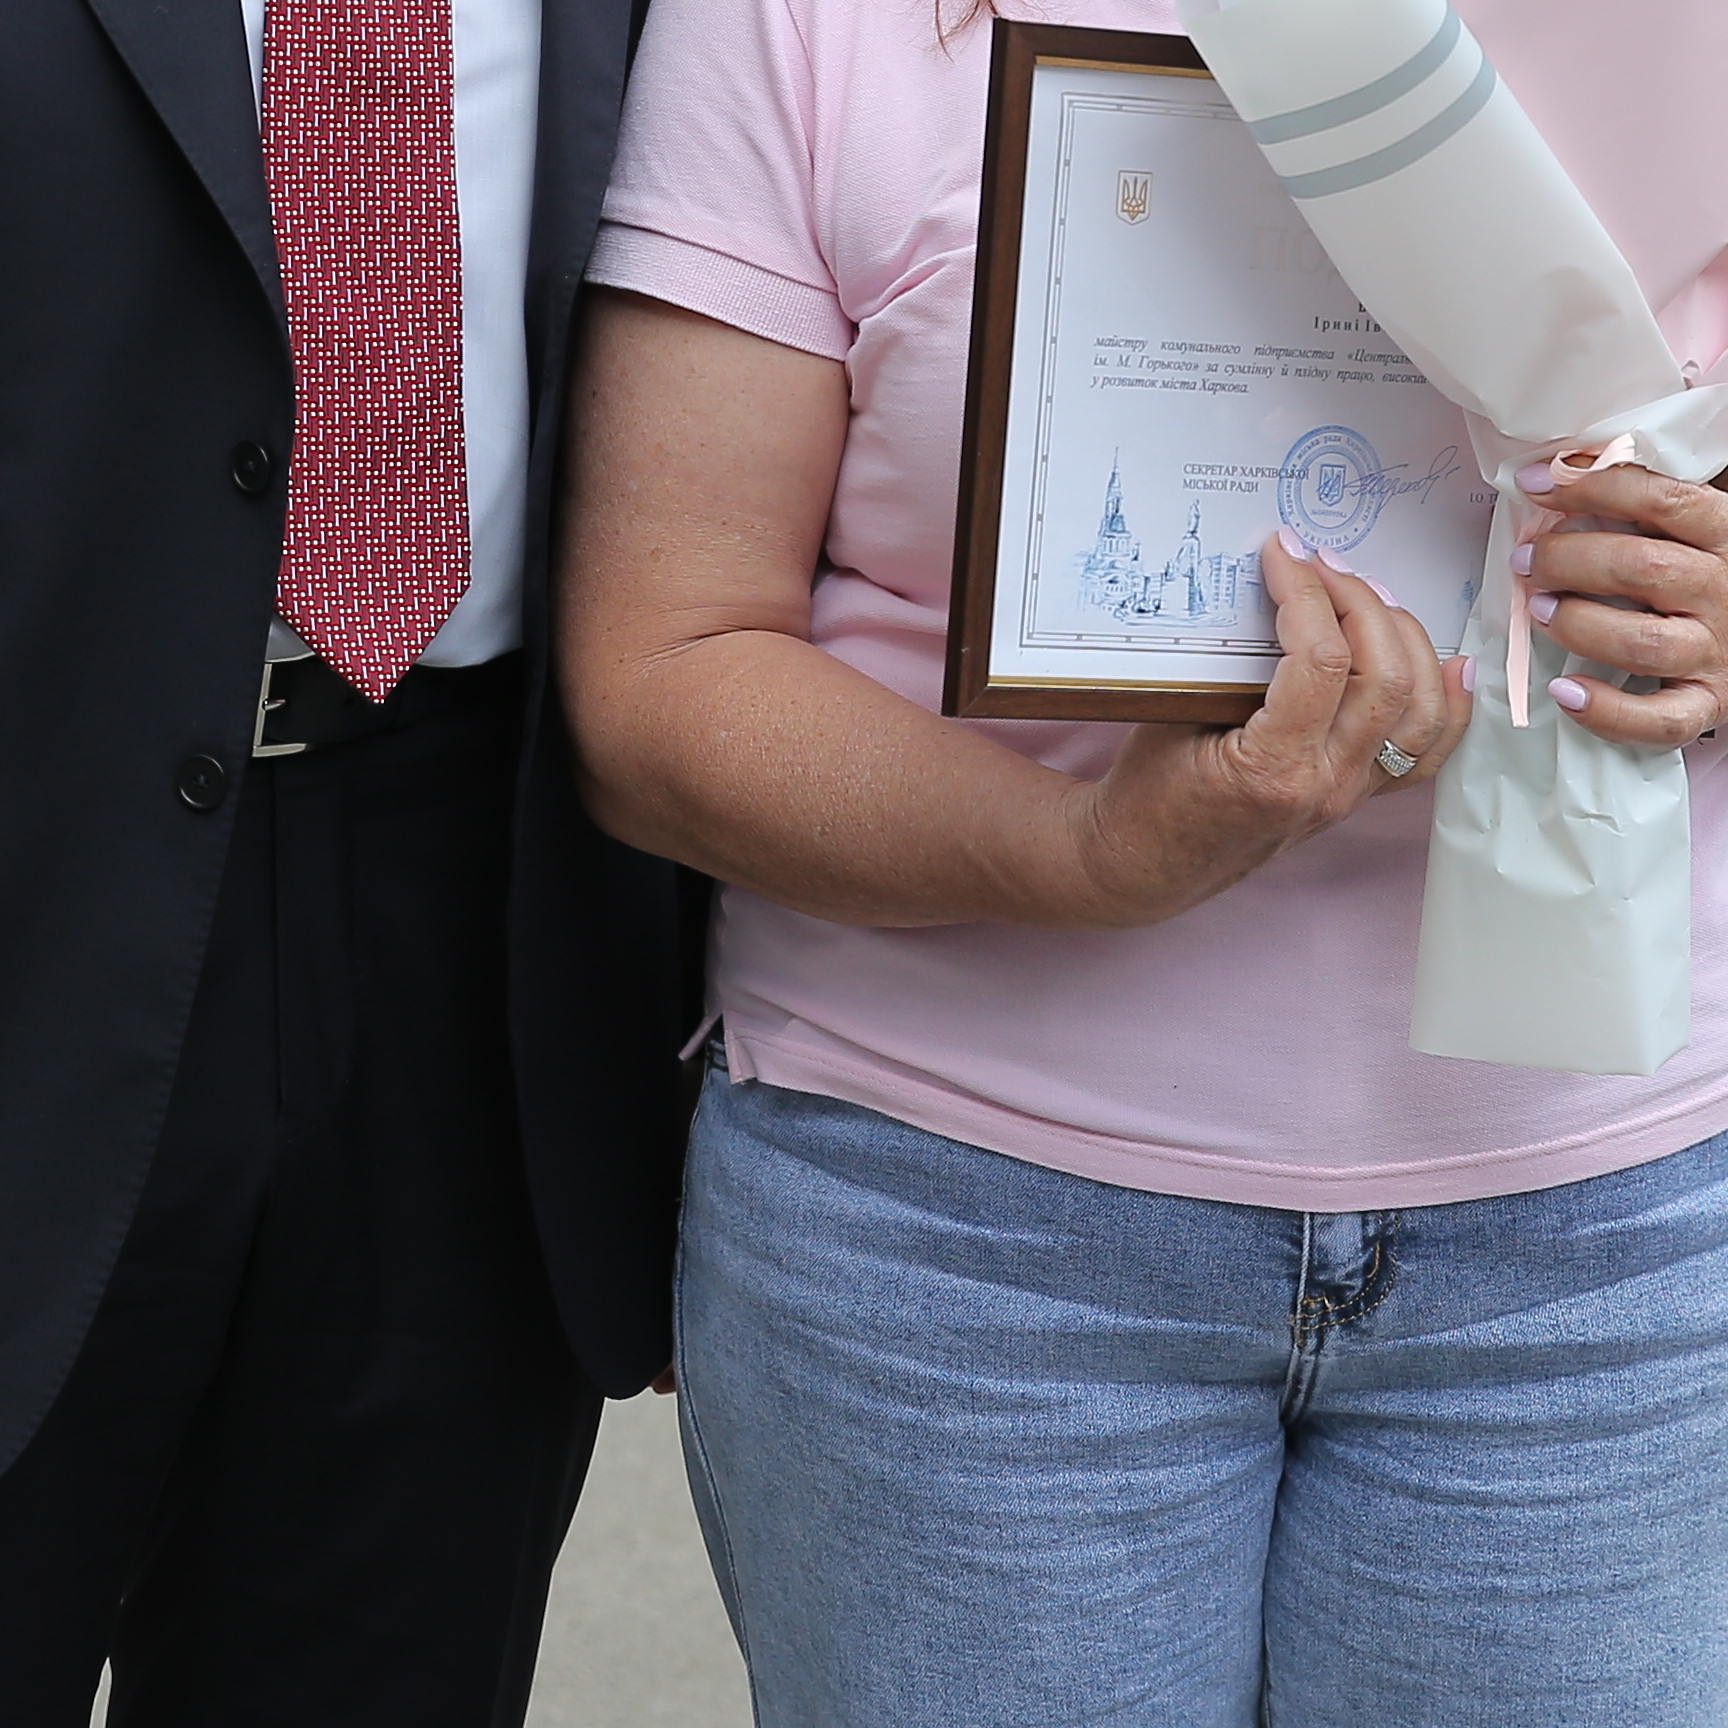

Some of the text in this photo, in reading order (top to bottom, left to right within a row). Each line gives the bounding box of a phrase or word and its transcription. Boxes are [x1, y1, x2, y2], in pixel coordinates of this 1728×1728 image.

[1314, 315, 1359, 333] Ірині
[1094, 334, 1148, 353] майстру
[1160, 340, 1241, 355] комунального
[1254, 342, 1335, 360] підприємства
[1138, 355, 1199, 373] Горького»
[1205, 363, 1219, 373] за
[1223, 362, 1276, 379] сумлінну
[1281, 363, 1289, 376] й
[1294, 365, 1331, 382] плідну
[1090, 376, 1100, 389] у
[1100, 376, 1159, 389] розвиток
[1159, 378, 1198, 391] міста
[1183, 463, 1239, 477] СЕКРЕТАР
[1182, 479, 1260, 494] МІСЬКОЇ РАДИ
